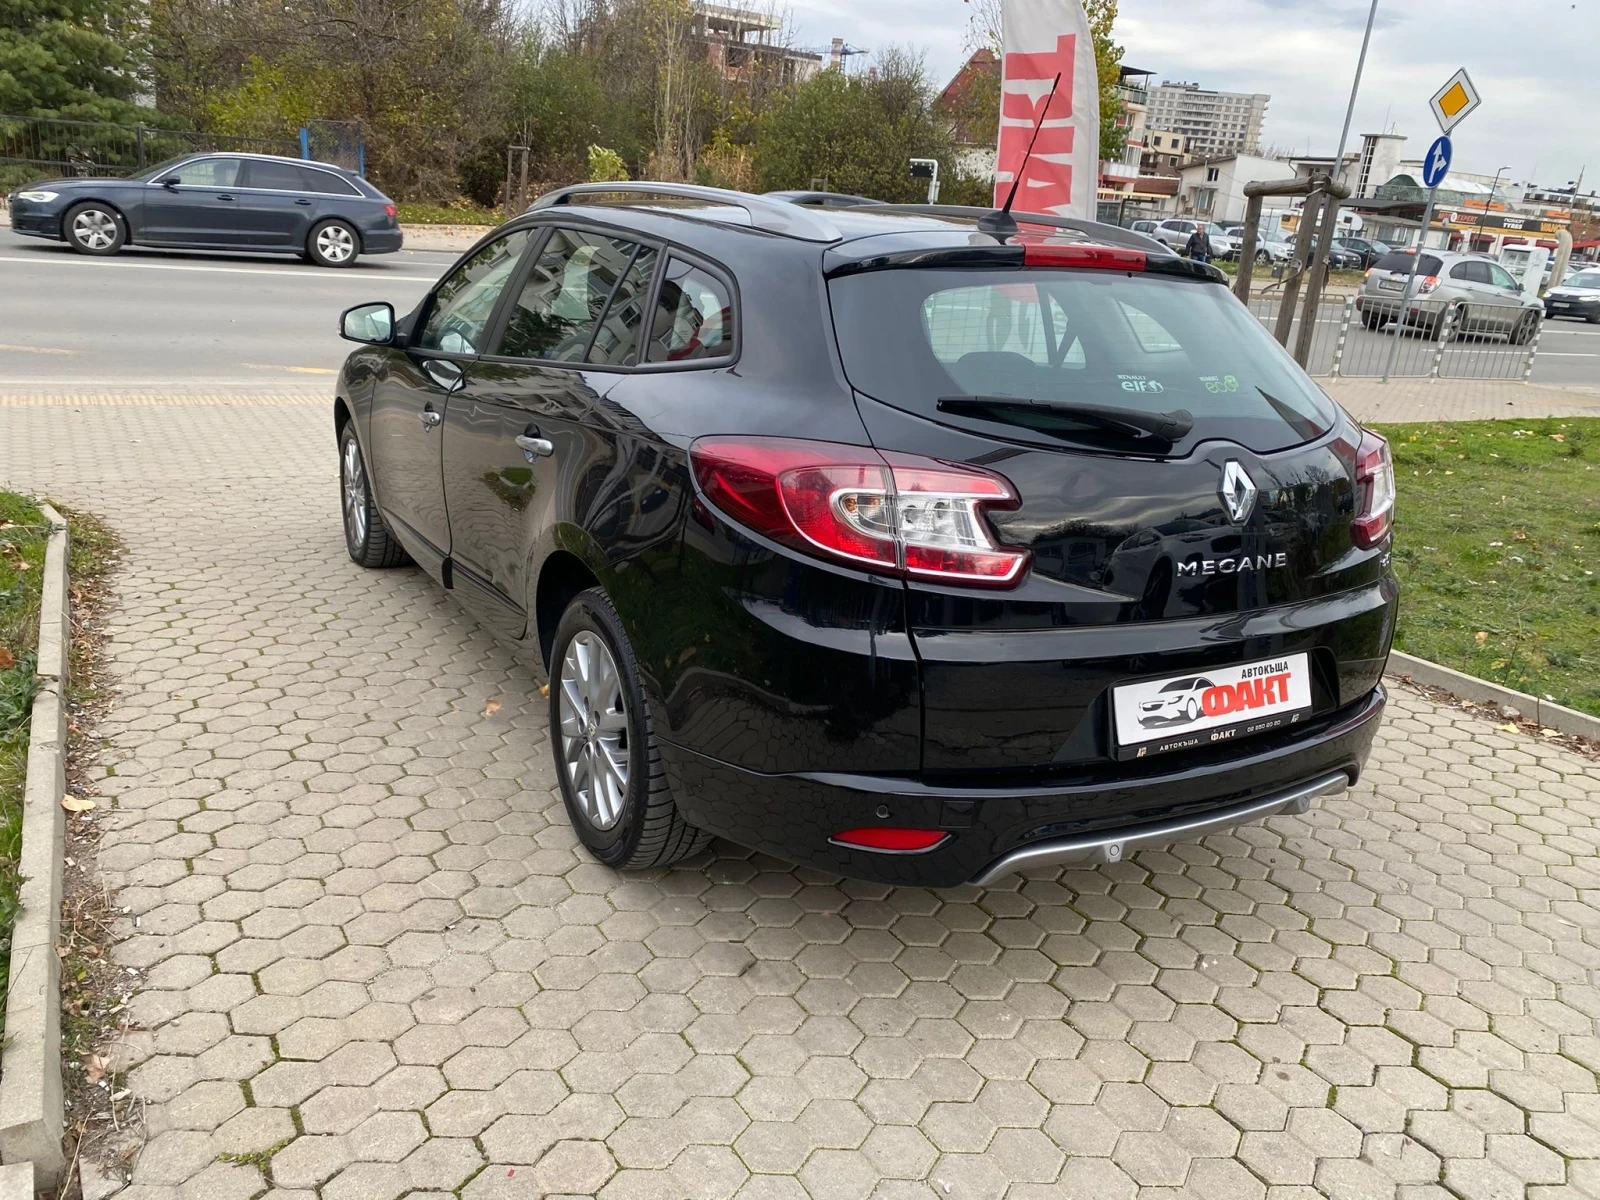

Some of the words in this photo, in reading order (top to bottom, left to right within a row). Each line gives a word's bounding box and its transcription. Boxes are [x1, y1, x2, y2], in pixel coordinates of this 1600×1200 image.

[1503, 222, 1523, 230] TYRES
[1121, 380, 1147, 392] elf
[1177, 552, 1287, 577] MEGANE
[1241, 661, 1289, 679] АВТОКЪЩА
[1202, 672, 1291, 716] ФАКТ
[1210, 729, 1236, 741] ФАКТ
